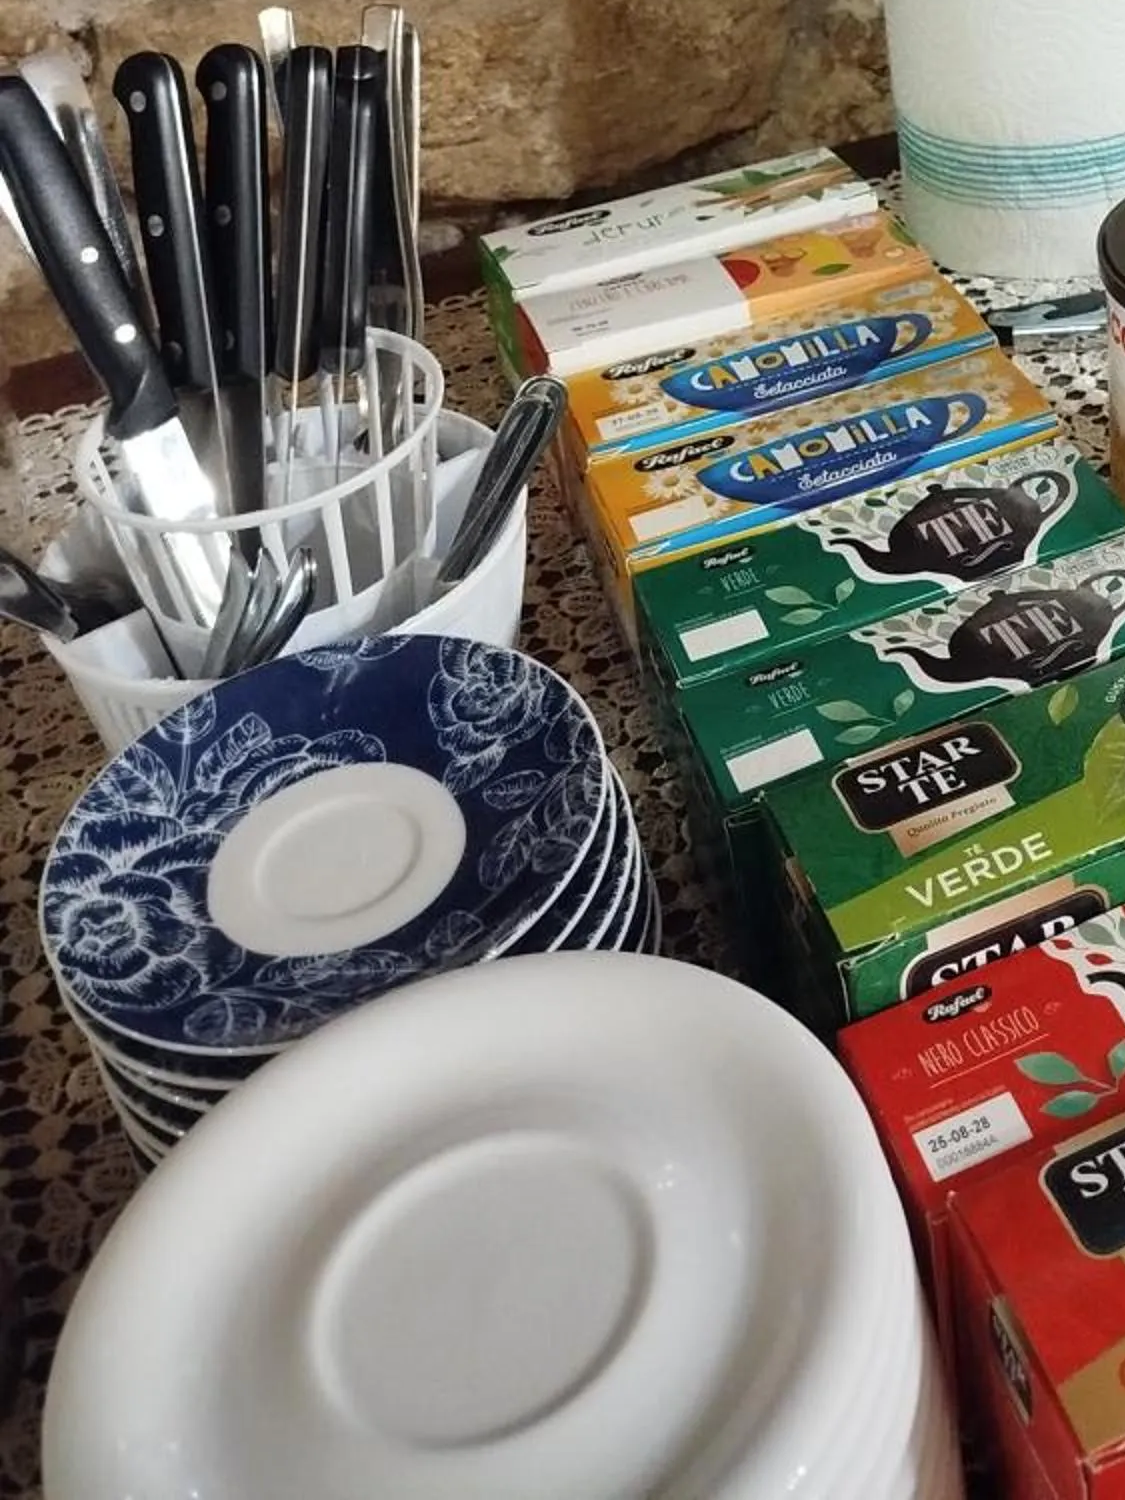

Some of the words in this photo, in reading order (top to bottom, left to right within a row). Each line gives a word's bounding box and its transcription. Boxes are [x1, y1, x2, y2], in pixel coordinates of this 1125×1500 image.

[690, 325, 881, 391] CAMOMILLA
[753, 365, 848, 400] Setacciata
[730, 406, 932, 483] CAMOMILLA
[798, 451, 897, 492] Setacciata
[720, 567, 762, 594] VERDE
[767, 682, 811, 710] VERDE
[856, 736, 982, 795] STAR
[904, 831, 1053, 908] VERDE
[927, 986, 986, 1022] Rafael
[916, 1039, 963, 1078] NERO
[962, 1005, 1040, 1058] CLASSICO
